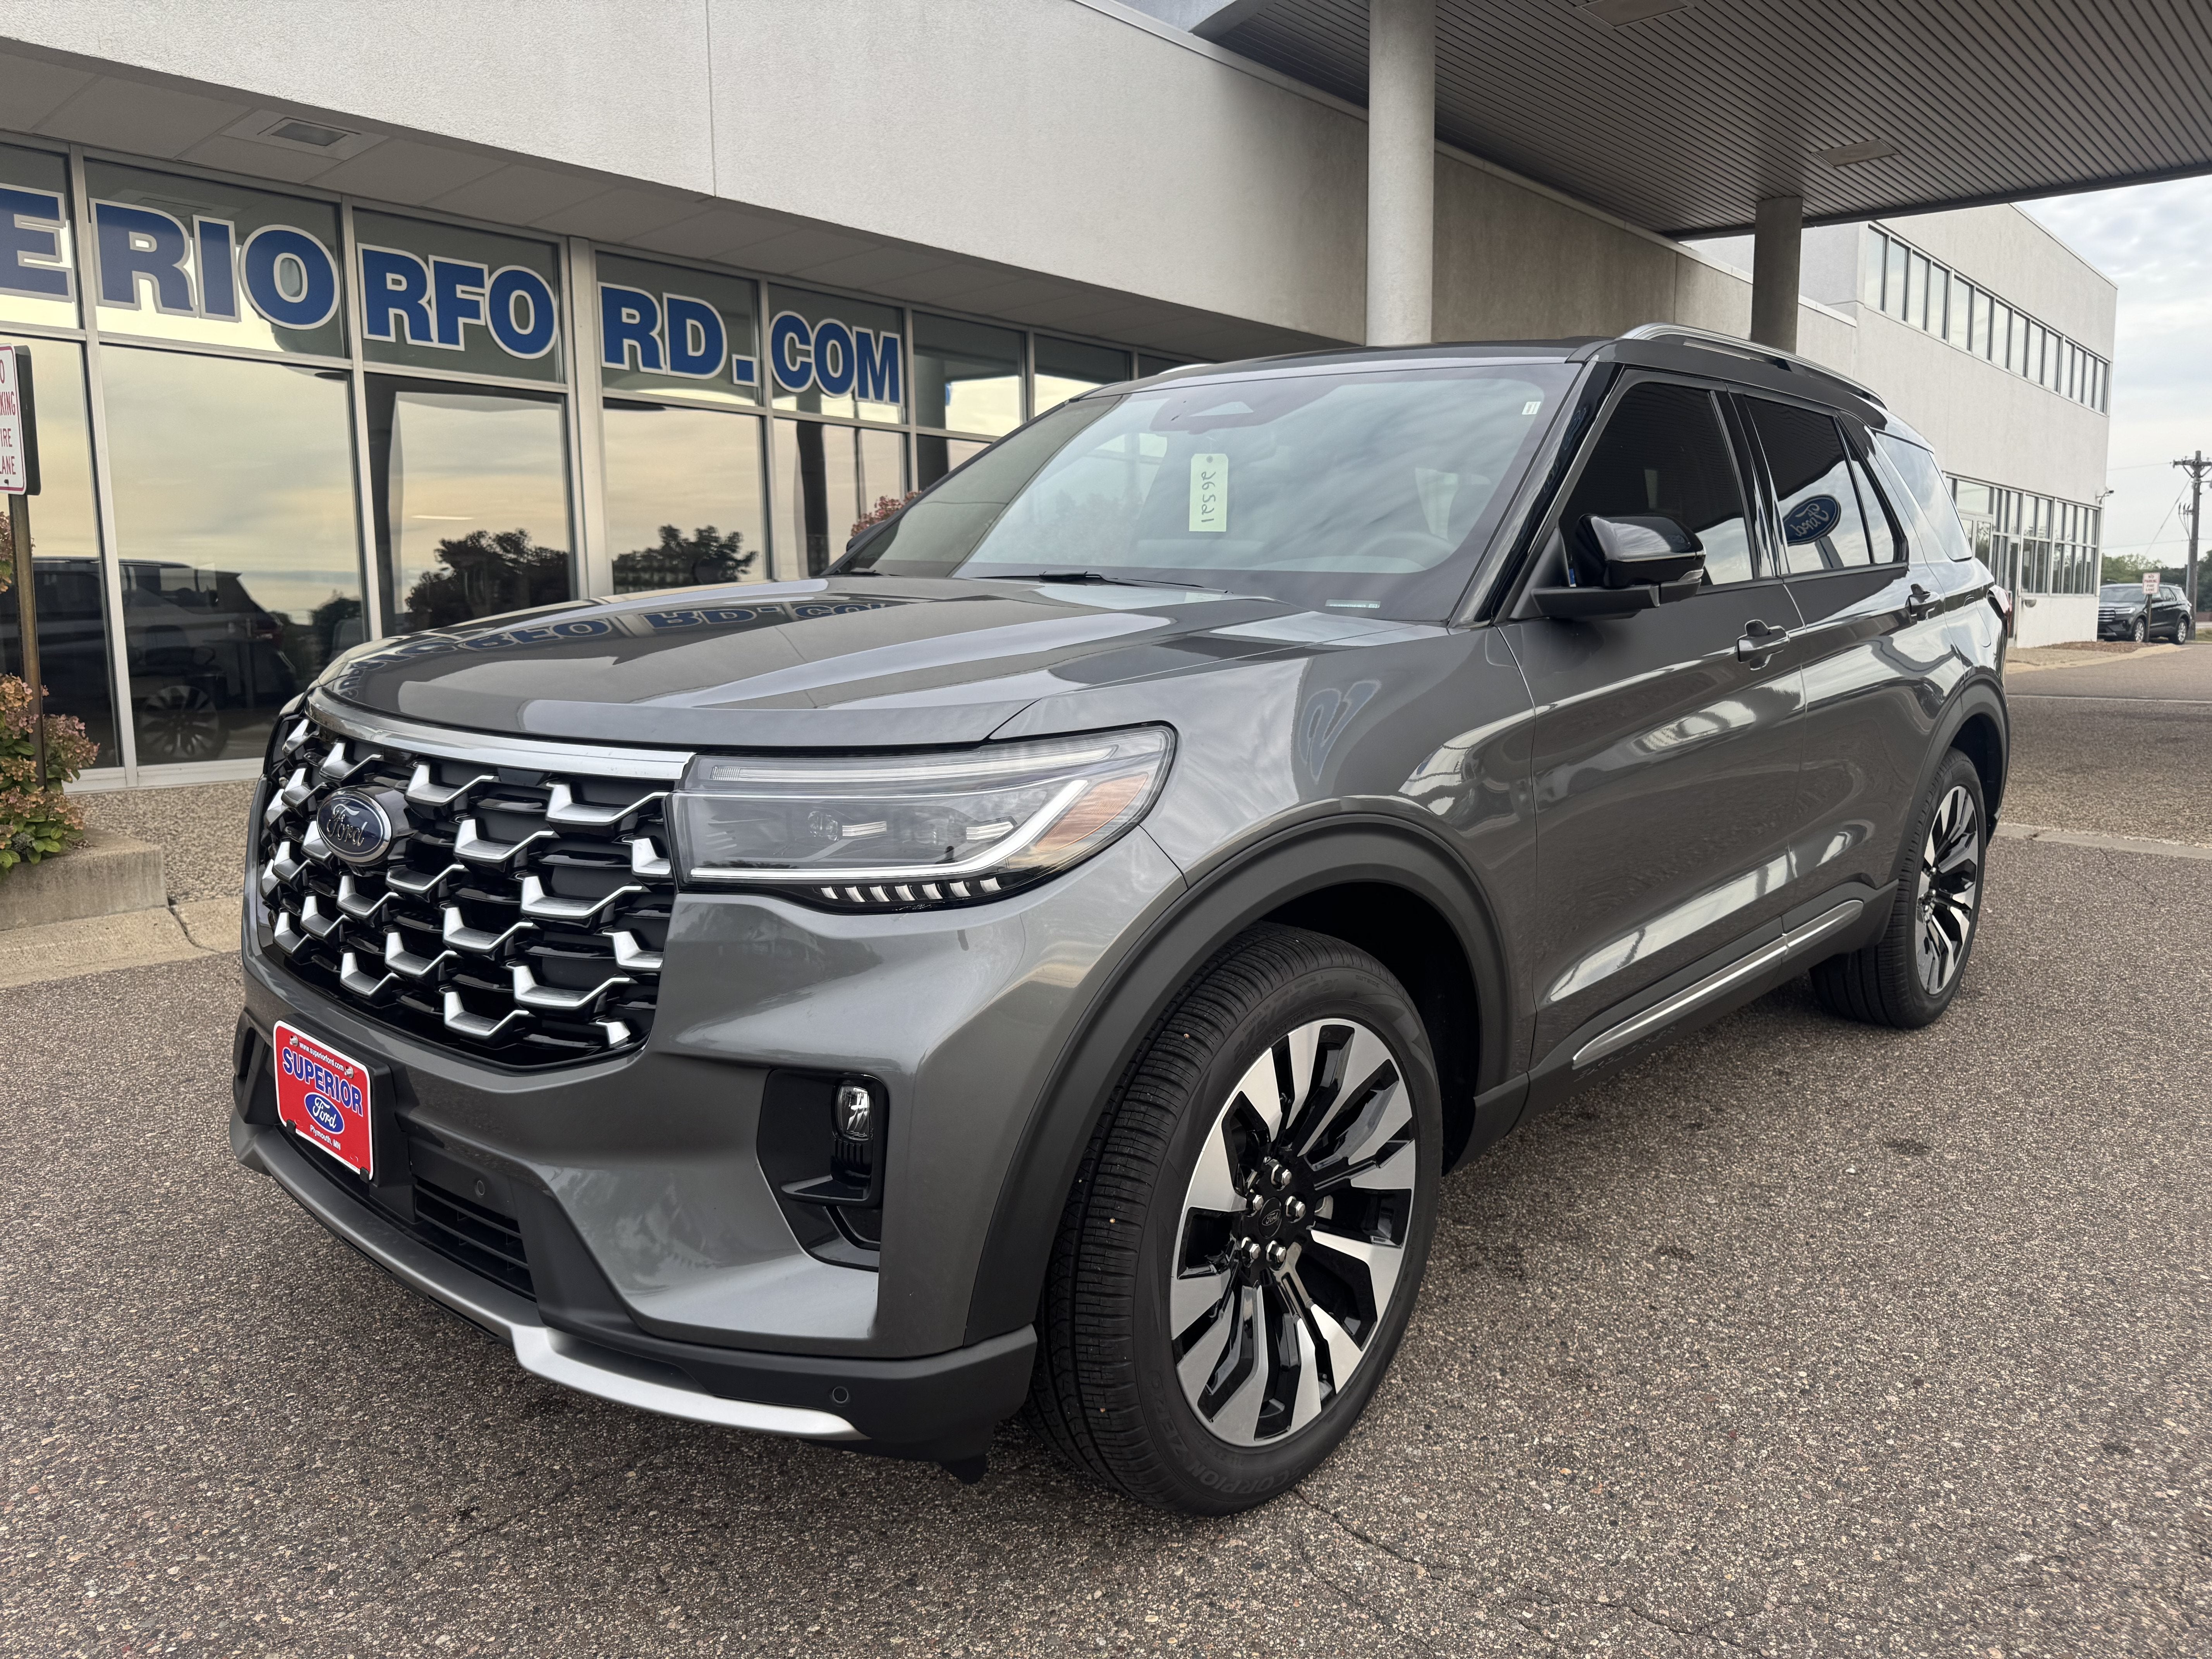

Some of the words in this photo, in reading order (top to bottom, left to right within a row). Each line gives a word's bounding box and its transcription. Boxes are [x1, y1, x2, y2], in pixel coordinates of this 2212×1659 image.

[0, 391, 15, 416] KING
[1201, 471, 1216, 523] 26521
[327, 803, 368, 847] Ford
[299, 1042, 344, 1072] www.superiorford.com
[282, 1047, 363, 1117] SUPERIOR
[313, 1097, 336, 1129] Ford
[310, 1124, 332, 1146] Plymouth,
[333, 1139, 341, 1151] MN
